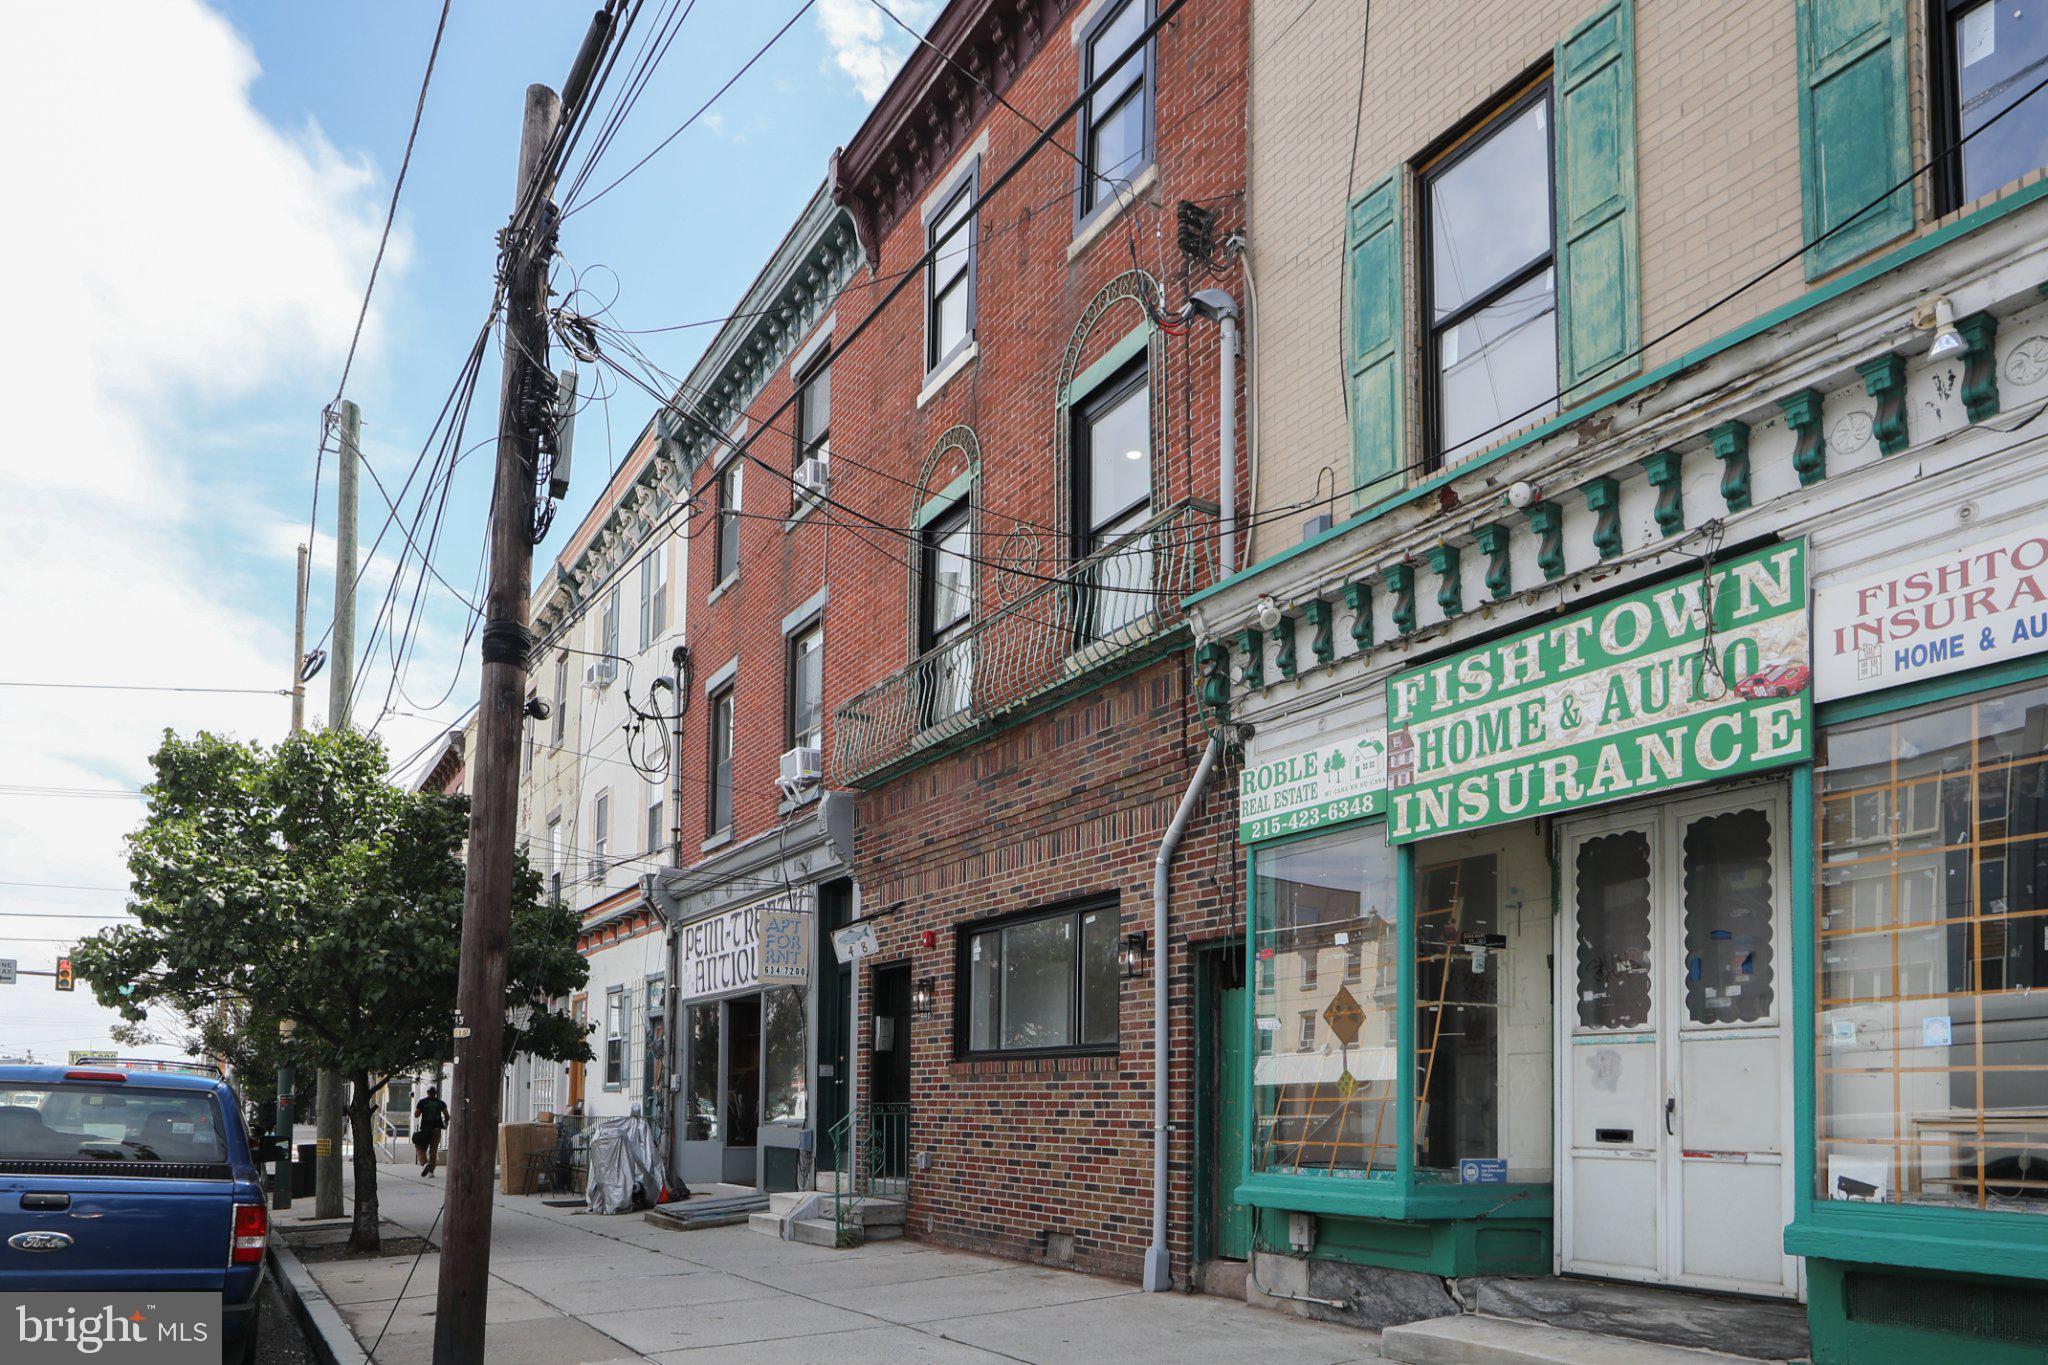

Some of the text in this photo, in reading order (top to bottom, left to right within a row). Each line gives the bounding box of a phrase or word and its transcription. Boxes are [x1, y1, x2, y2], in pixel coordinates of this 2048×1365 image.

[1392, 547, 1798, 723] FISHTOWN
[1894, 633, 1965, 672] HOME
[1979, 626, 1996, 652] &
[1417, 637, 1759, 774] HOME & AUTO
[1241, 751, 1318, 796] ROBLE
[1392, 698, 1802, 838] INSURANCE
[1241, 782, 1318, 818] REAL ESTATE
[1251, 794, 1375, 839] 215-423-6348
[765, 917, 802, 933] APT
[765, 932, 802, 949] FOR
[22, 1235, 64, 1249] Ford
